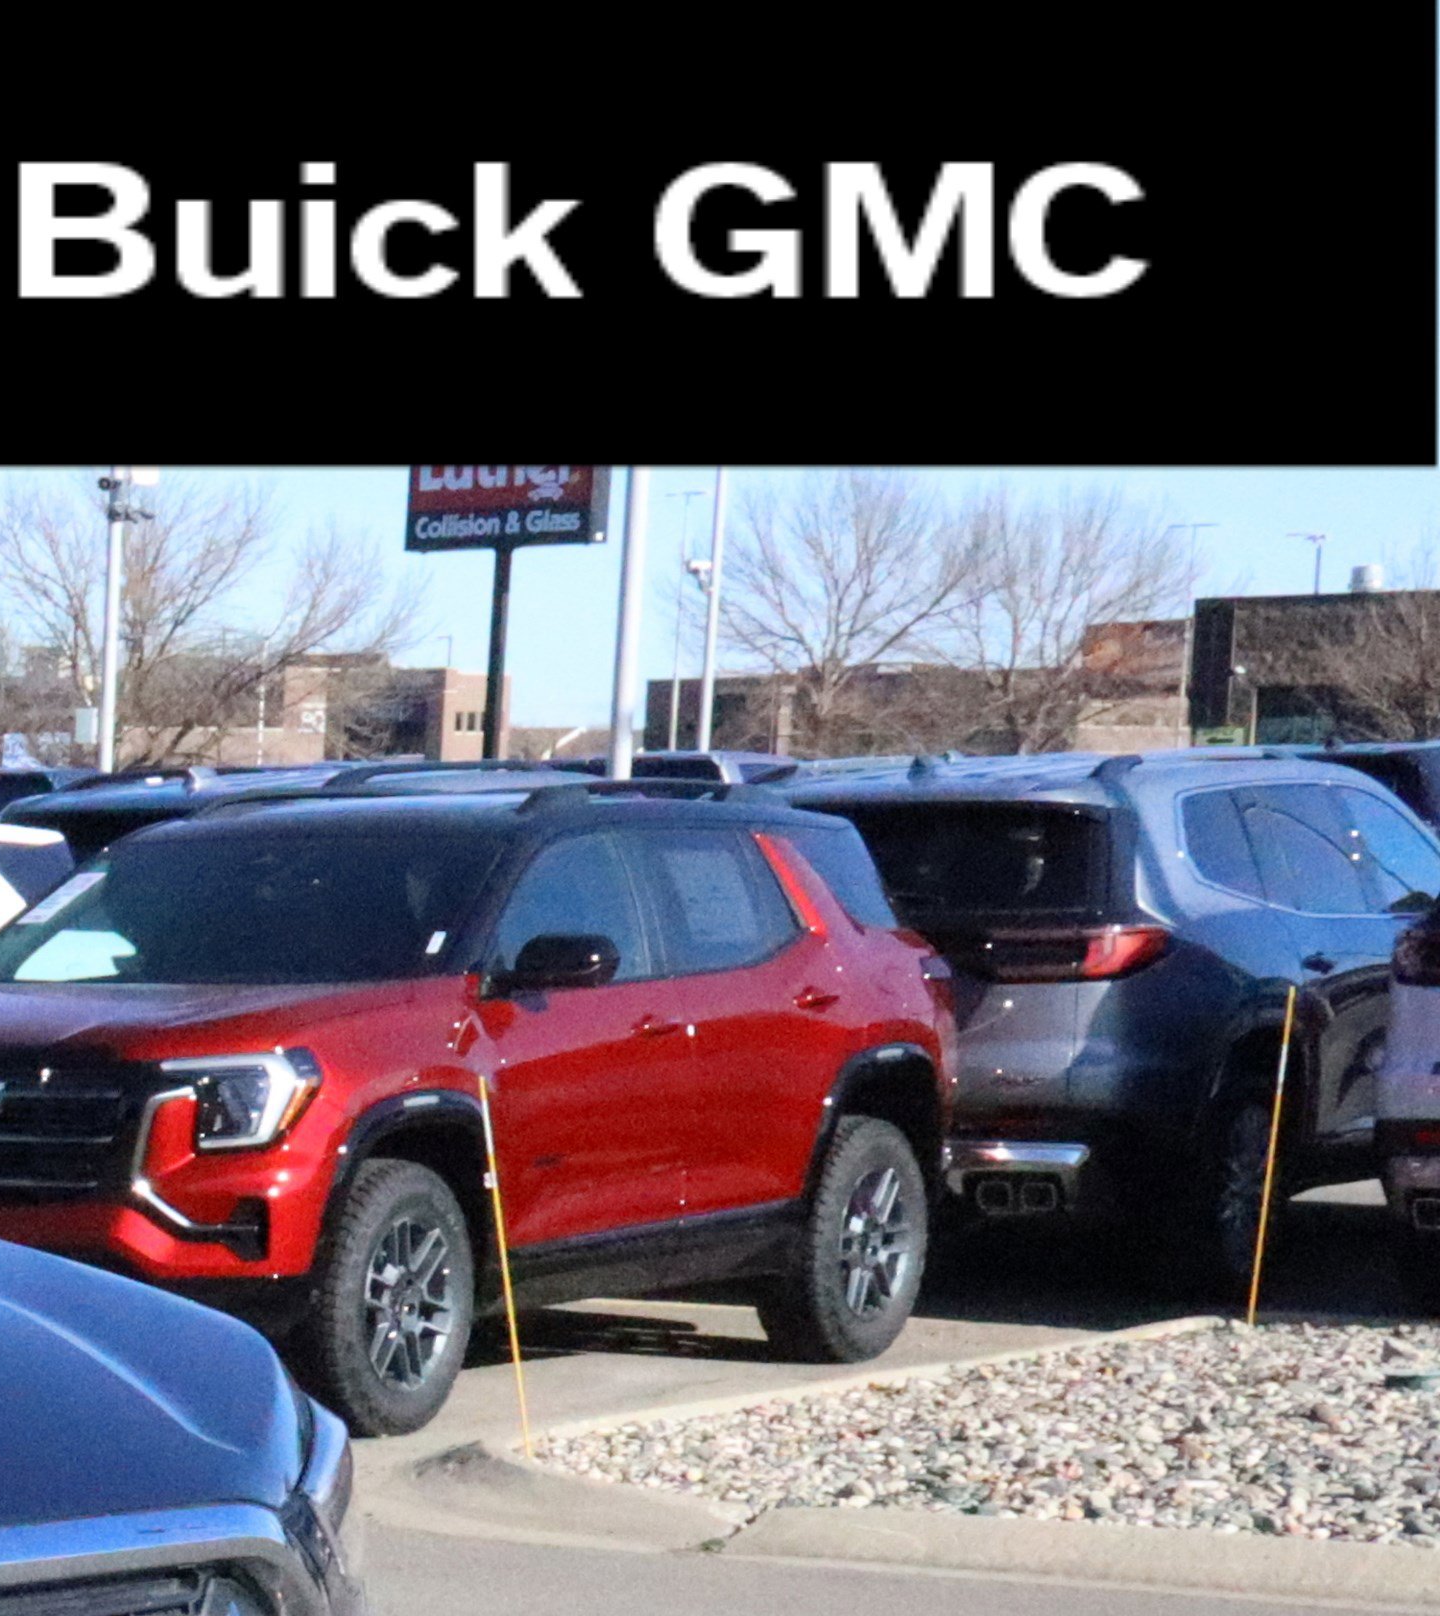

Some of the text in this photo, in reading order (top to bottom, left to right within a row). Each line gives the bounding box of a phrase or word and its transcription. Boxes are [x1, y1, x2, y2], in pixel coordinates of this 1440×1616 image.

[415, 509, 580, 539] Collision & Glass
